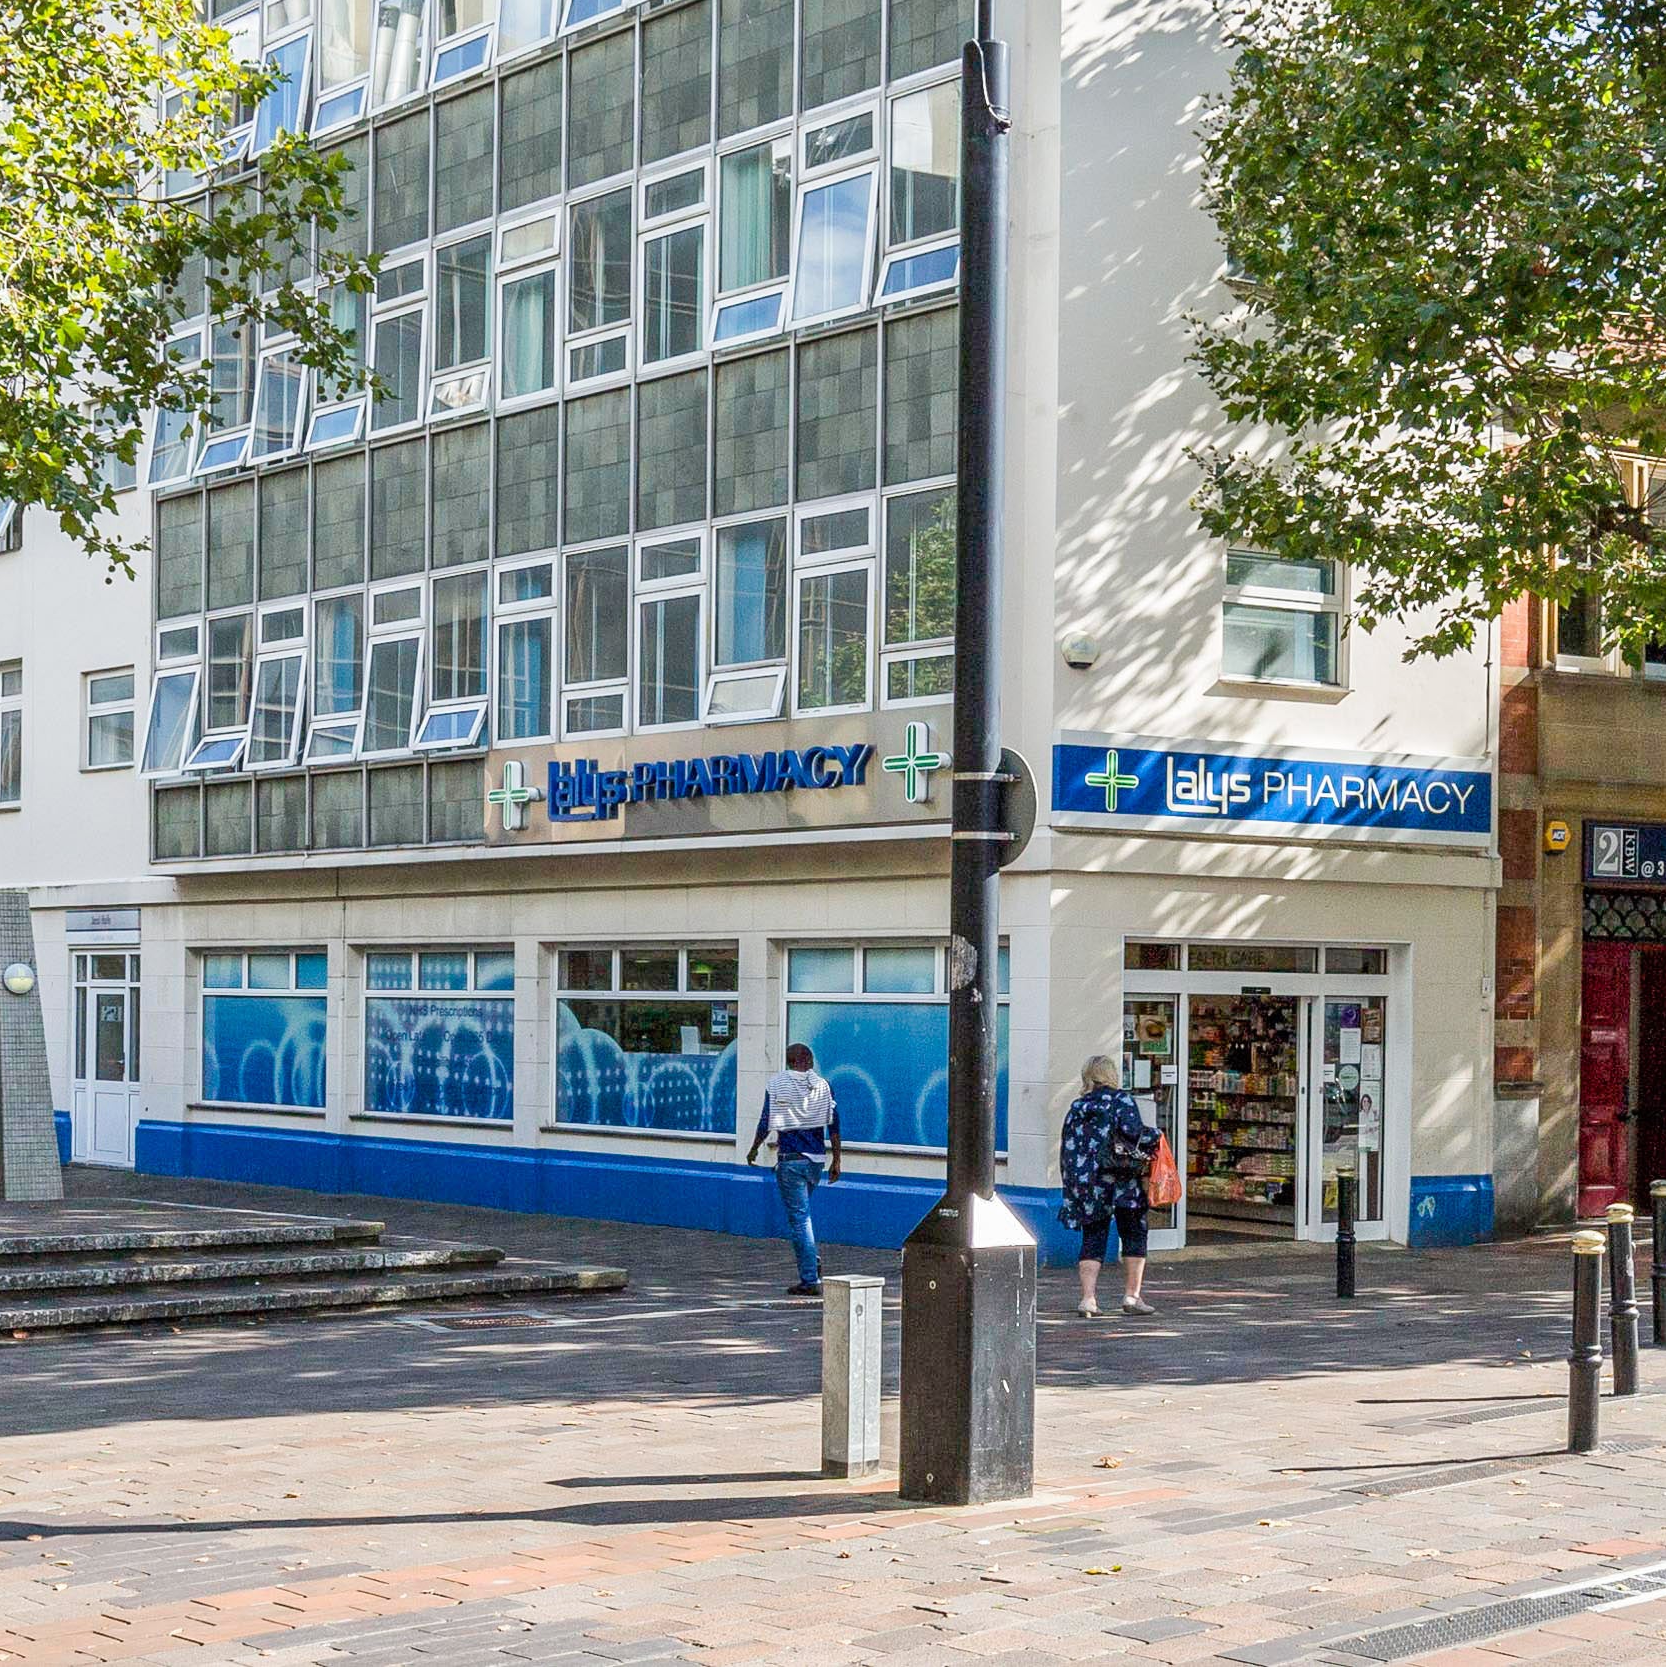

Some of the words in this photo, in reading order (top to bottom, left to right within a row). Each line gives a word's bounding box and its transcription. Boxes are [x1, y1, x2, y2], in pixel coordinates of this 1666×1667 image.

[633, 743, 875, 801] PHARMACY
[1263, 771, 1475, 815] PHARMACY
[1597, 831, 1619, 872] 2
[1624, 834, 1636, 873] KBW
[1641, 860, 1655, 877] @
[1657, 860, 1665, 875] 3
